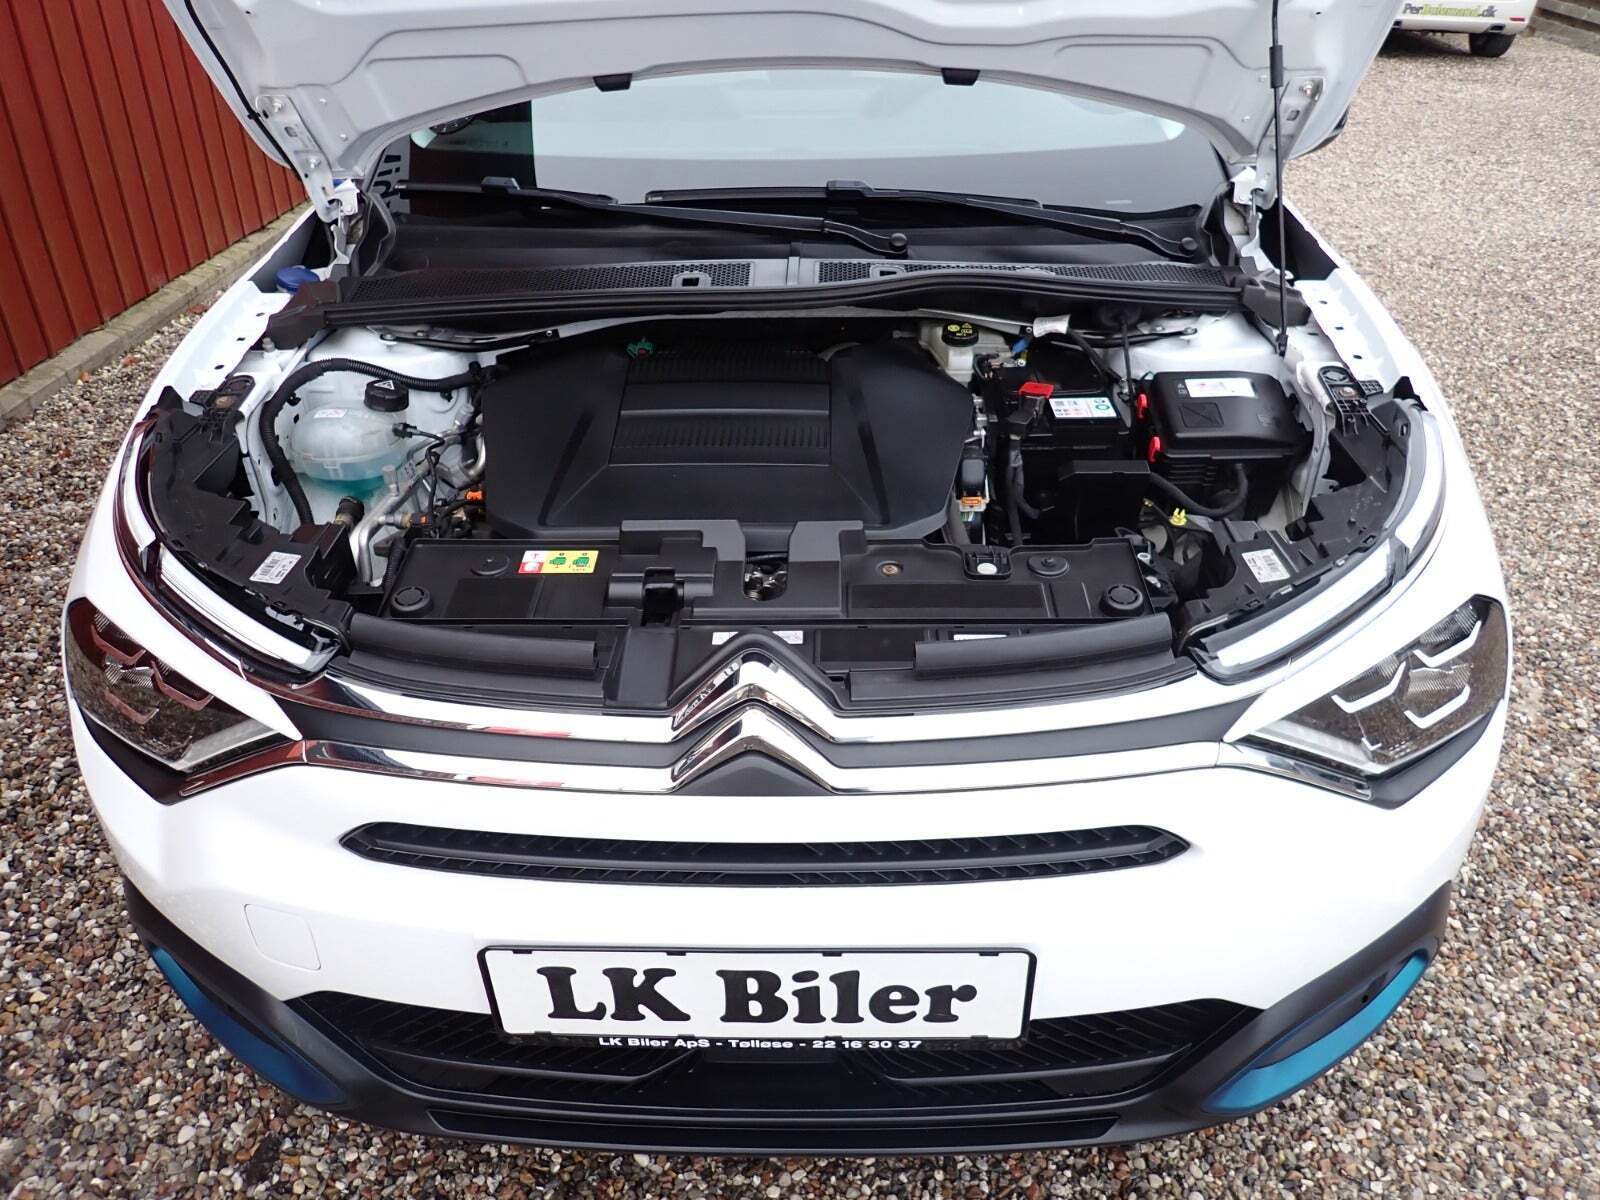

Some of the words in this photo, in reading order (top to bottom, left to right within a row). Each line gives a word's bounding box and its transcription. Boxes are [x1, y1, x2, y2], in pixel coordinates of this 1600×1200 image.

[536, 966, 691, 1021] LK
[715, 970, 977, 1024] Biler
[599, 1037, 623, 1046] LK
[627, 1037, 669, 1047] Biler
[674, 1038, 710, 1049] ApS
[728, 1039, 793, 1049] Tølløse
[812, 1040, 836, 1049] 22
[842, 1040, 862, 1049] 16
[868, 1040, 892, 1049] 30
[898, 1040, 922, 1049] 37
